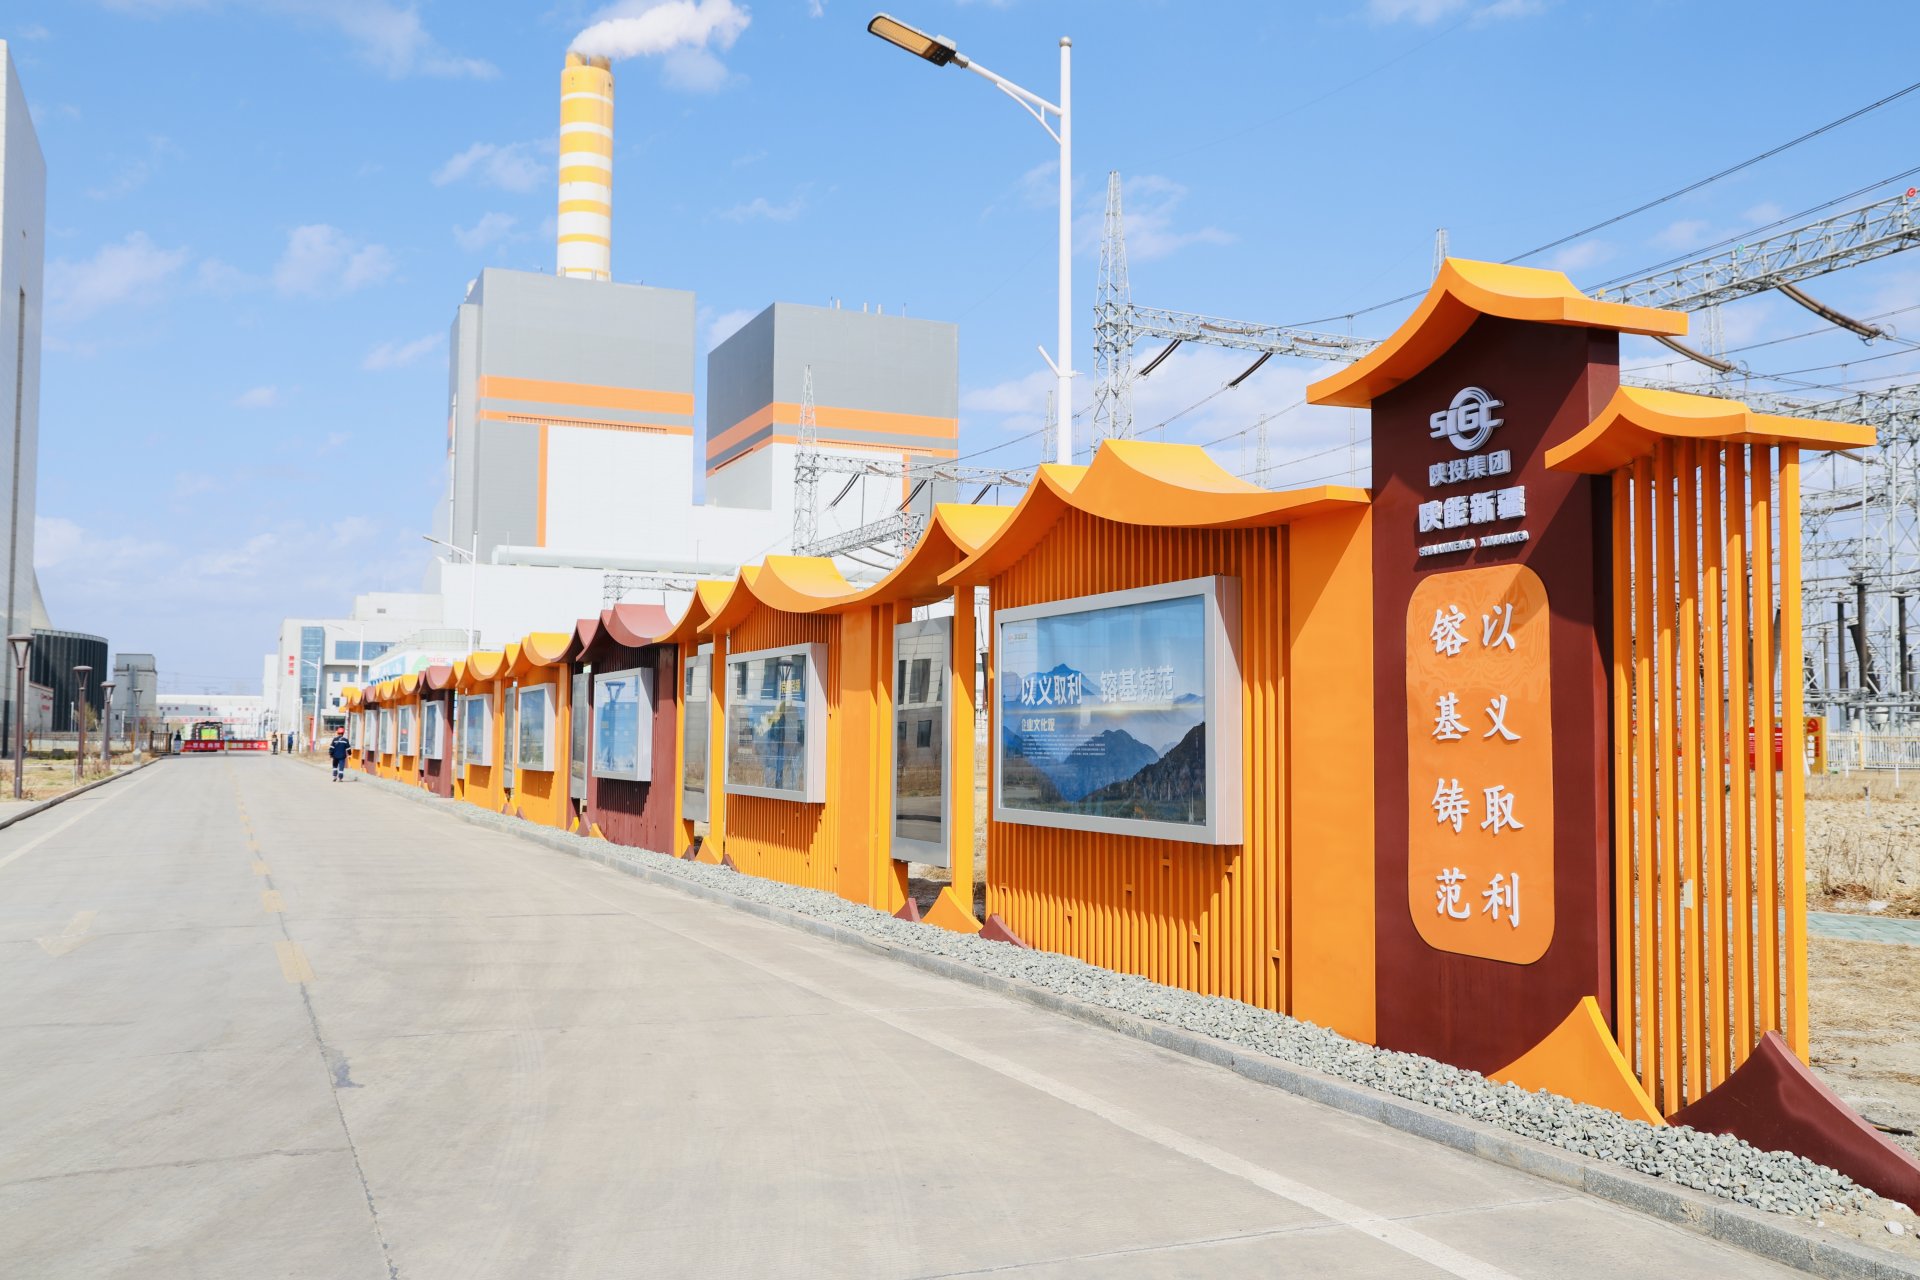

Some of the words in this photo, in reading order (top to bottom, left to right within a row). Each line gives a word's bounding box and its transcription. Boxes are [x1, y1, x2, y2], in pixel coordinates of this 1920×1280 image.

[1429, 399, 1505, 440] SIGC
[1428, 449, 1512, 487] 陕投集团
[1418, 485, 1527, 533] 陕能新疆
[1418, 538, 1476, 557] SHAANNENG
[1479, 530, 1530, 548] XINJIANG
[1020, 672, 1083, 707] 以义取利
[1099, 664, 1177, 706] 镕基铸范
[1429, 603, 1472, 920] 镕基铸范
[1480, 604, 1525, 930] 以义取利
